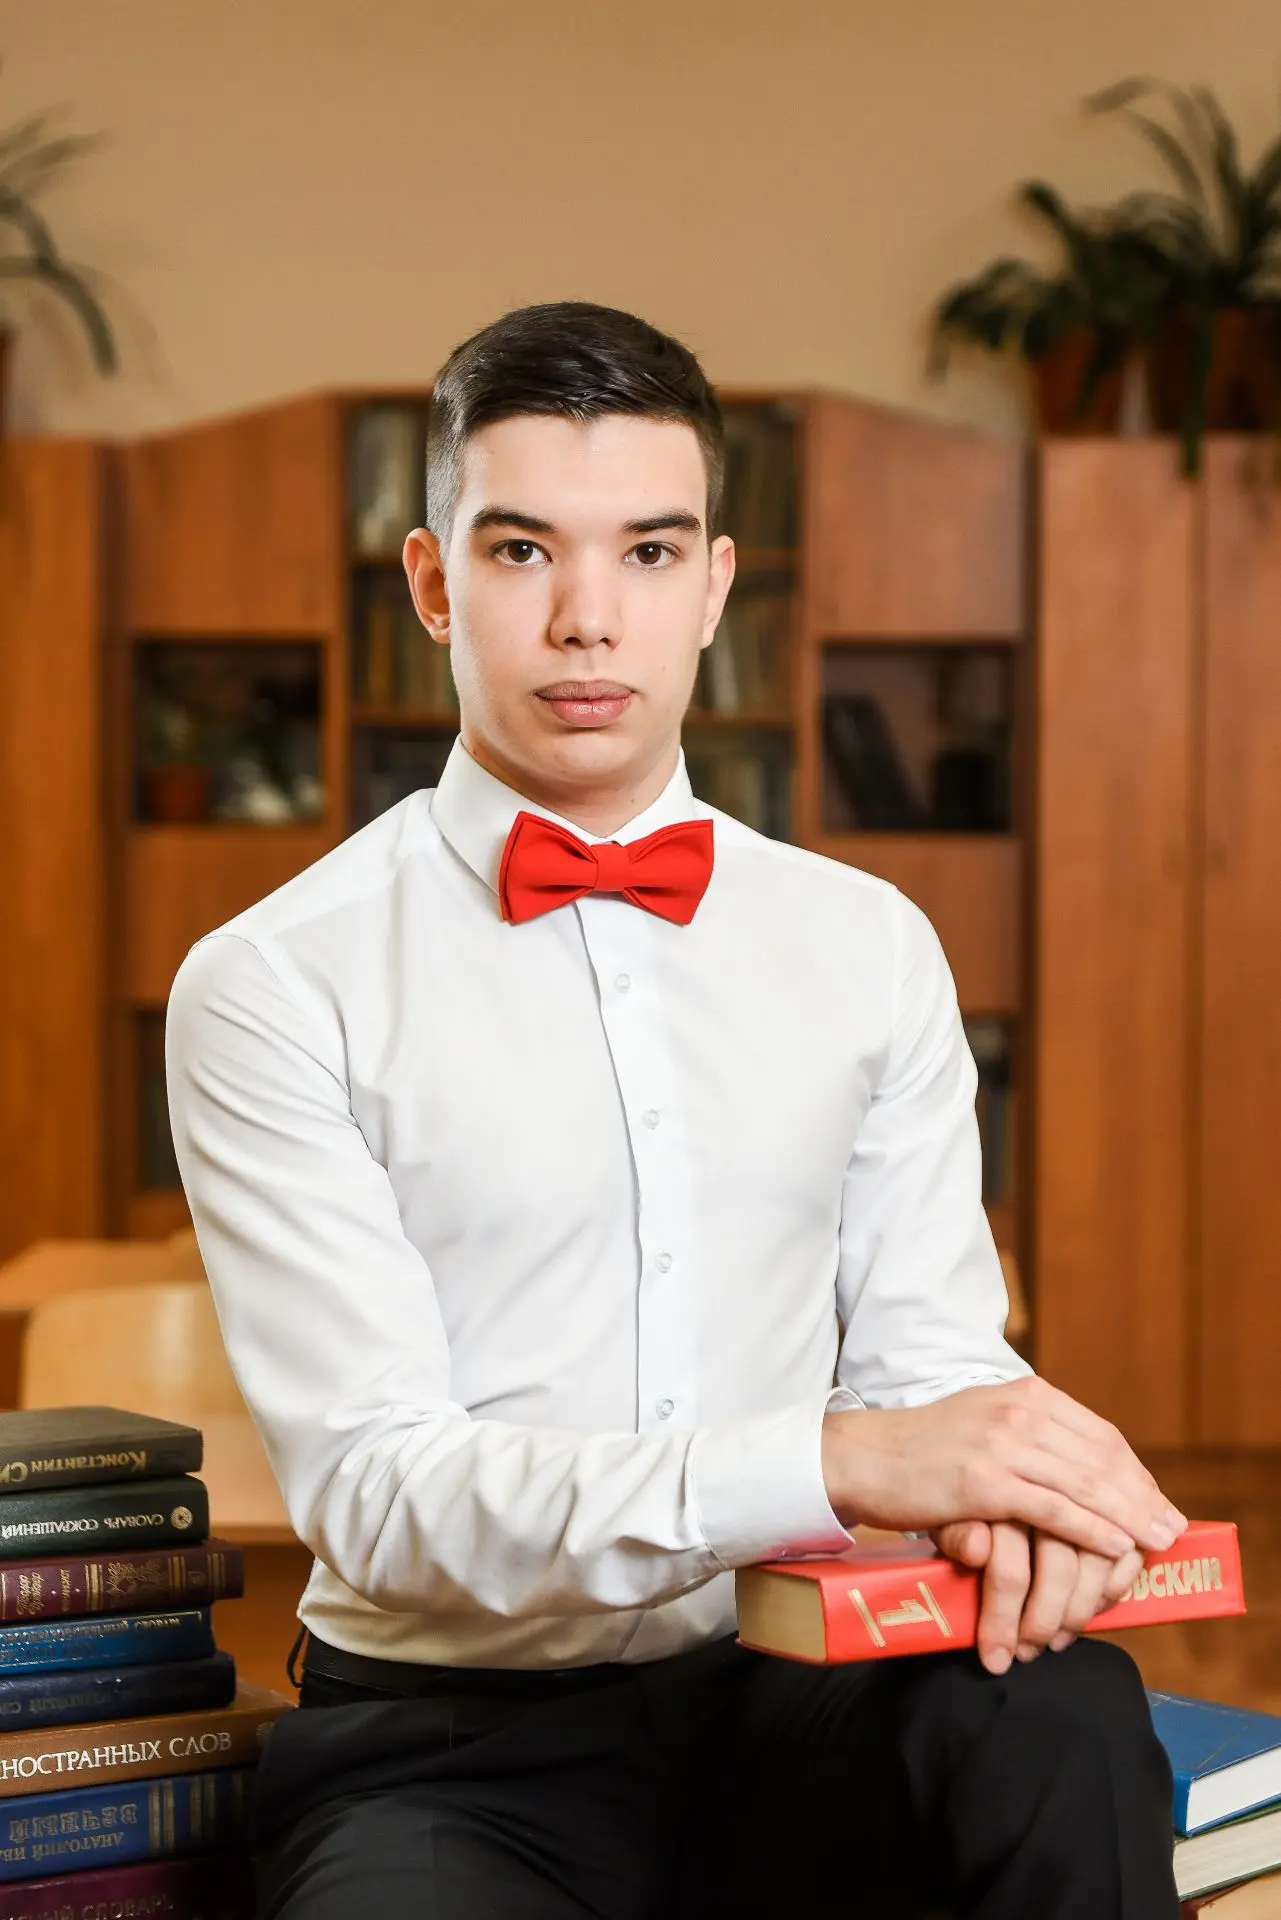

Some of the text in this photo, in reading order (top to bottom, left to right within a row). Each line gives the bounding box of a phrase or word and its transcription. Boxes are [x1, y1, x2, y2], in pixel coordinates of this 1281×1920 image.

[1, 1513, 165, 1540] СЛОВАРЬ СОКРАЩЕНИЙ
[1120, 1557, 1223, 1603] ВСКИЙ
[0, 1732, 232, 1780] НОСТРАННЫХ СЛОВ
[10, 1803, 138, 1844] ВЕЧНЫЙ
[32, 1832, 125, 1862] АНАТОЛИЙ
